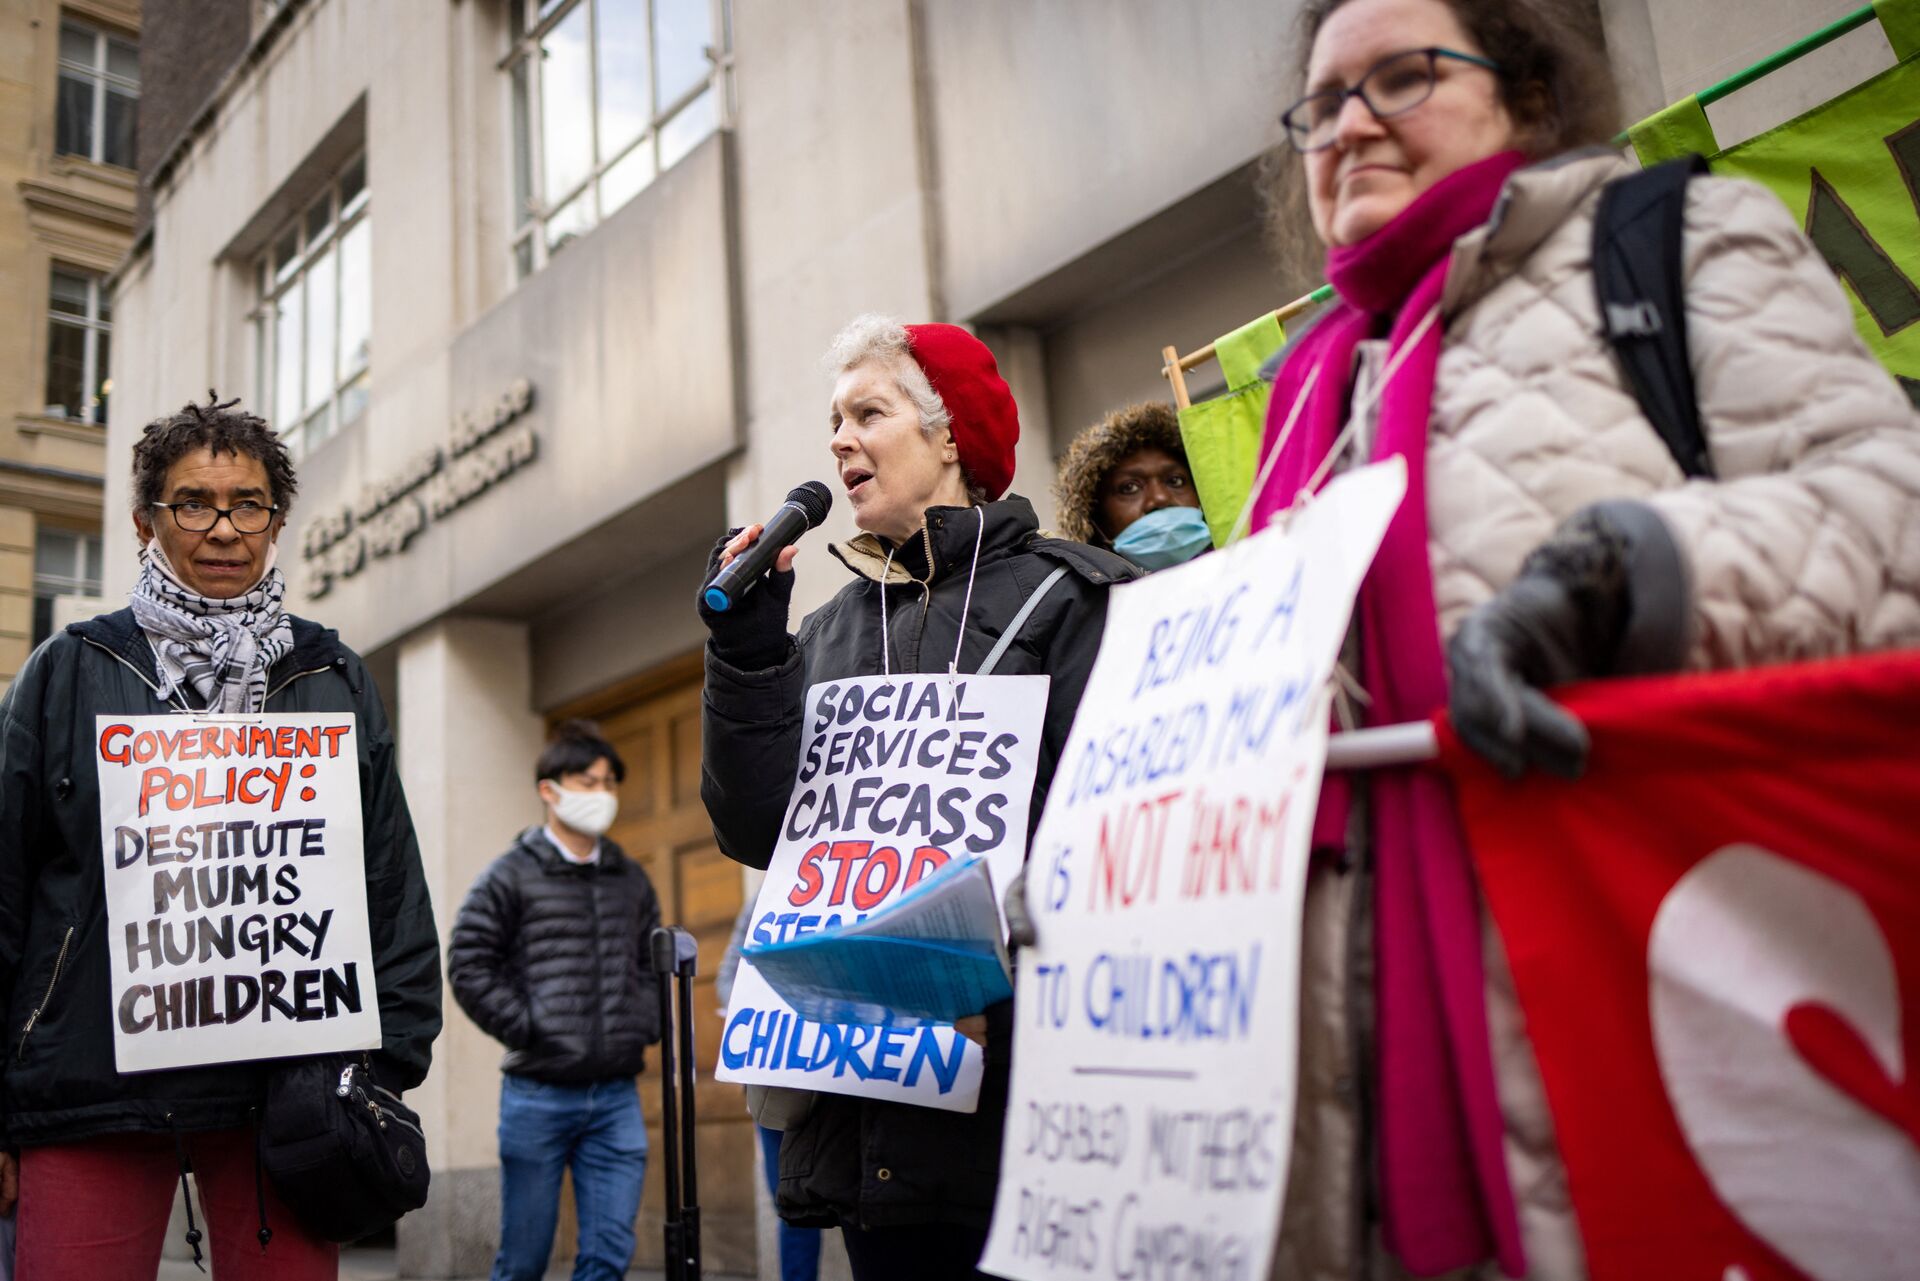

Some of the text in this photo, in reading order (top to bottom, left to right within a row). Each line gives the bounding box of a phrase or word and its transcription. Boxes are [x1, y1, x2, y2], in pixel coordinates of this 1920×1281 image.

[1130, 555, 1305, 701] BEING A
[814, 681, 985, 733] SOCIAL
[99, 723, 351, 767] GOVERNMENT
[798, 725, 1019, 783] SERVICES
[1066, 700, 1209, 808] DISABLED
[138, 762, 317, 818] POLICY:
[786, 776, 1009, 853] CAFCASS
[115, 818, 326, 869] DESTITUTE
[1088, 789, 1184, 912] NOT
[153, 863, 302, 915] MUMS
[125, 909, 334, 973] HUNGRY
[118, 962, 363, 1034] CHILDREN
[1036, 963, 1071, 1030] TO
[1083, 940, 1264, 1042] CHILDREN
[721, 1007, 968, 1095] CHILDREN
[1025, 1100, 1129, 1167] DISABLED
